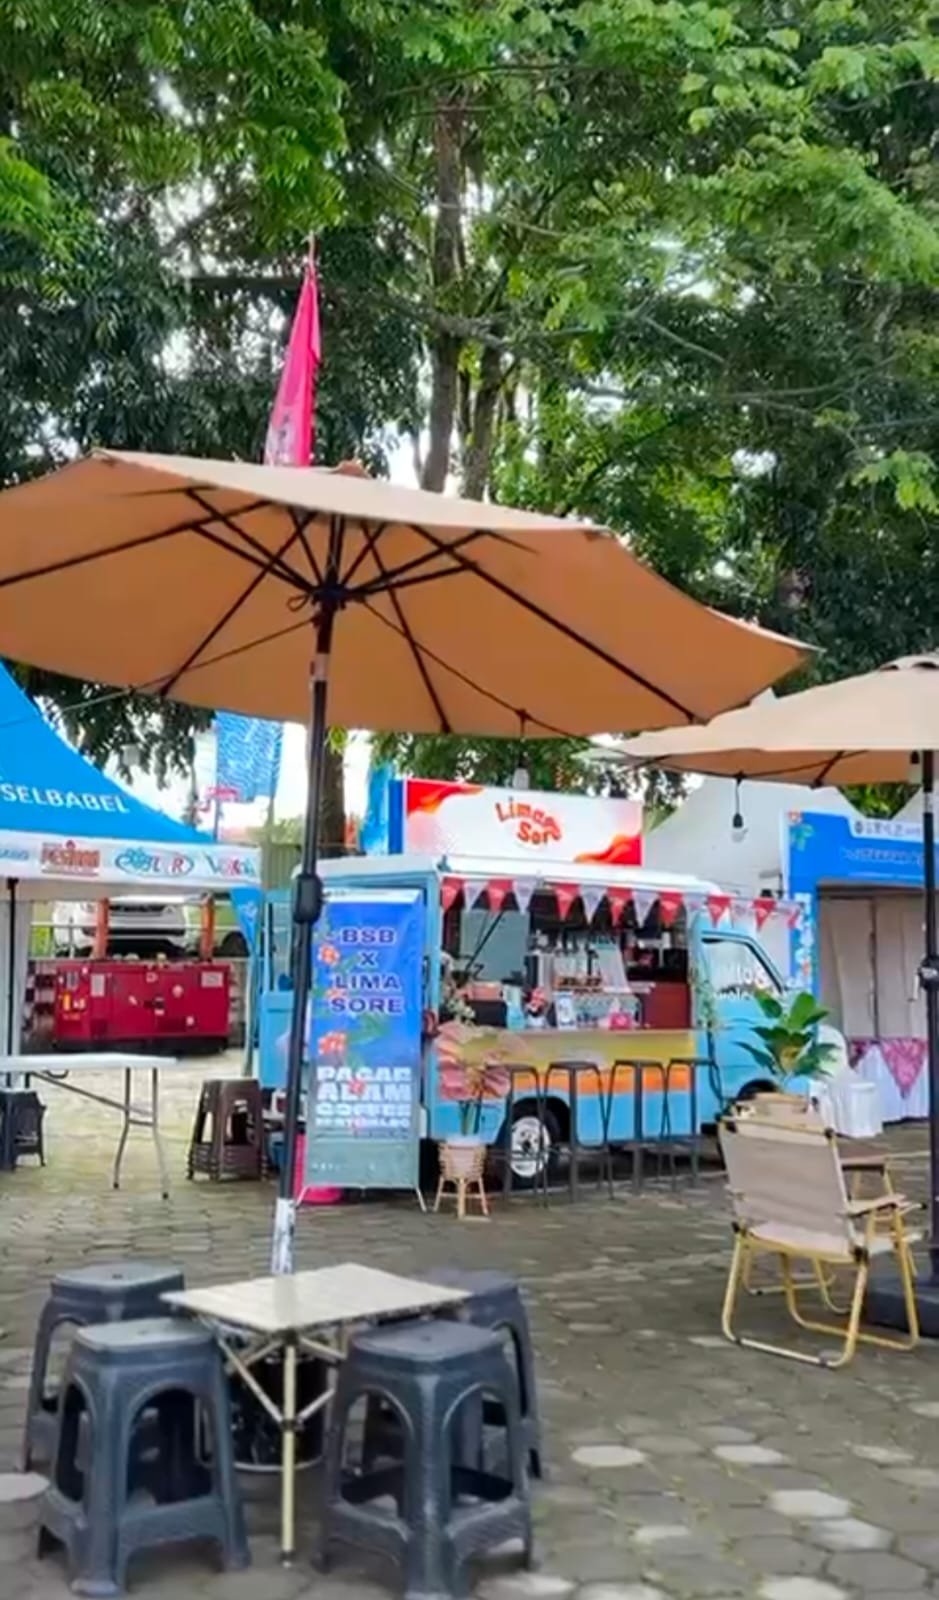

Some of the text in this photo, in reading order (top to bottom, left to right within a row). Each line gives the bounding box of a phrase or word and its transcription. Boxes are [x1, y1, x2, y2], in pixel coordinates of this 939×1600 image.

[0, 783, 130, 814] SELBABEL
[340, 928, 396, 945] BSB
[334, 974, 400, 990] LIMA
[330, 998, 404, 1014] SORE
